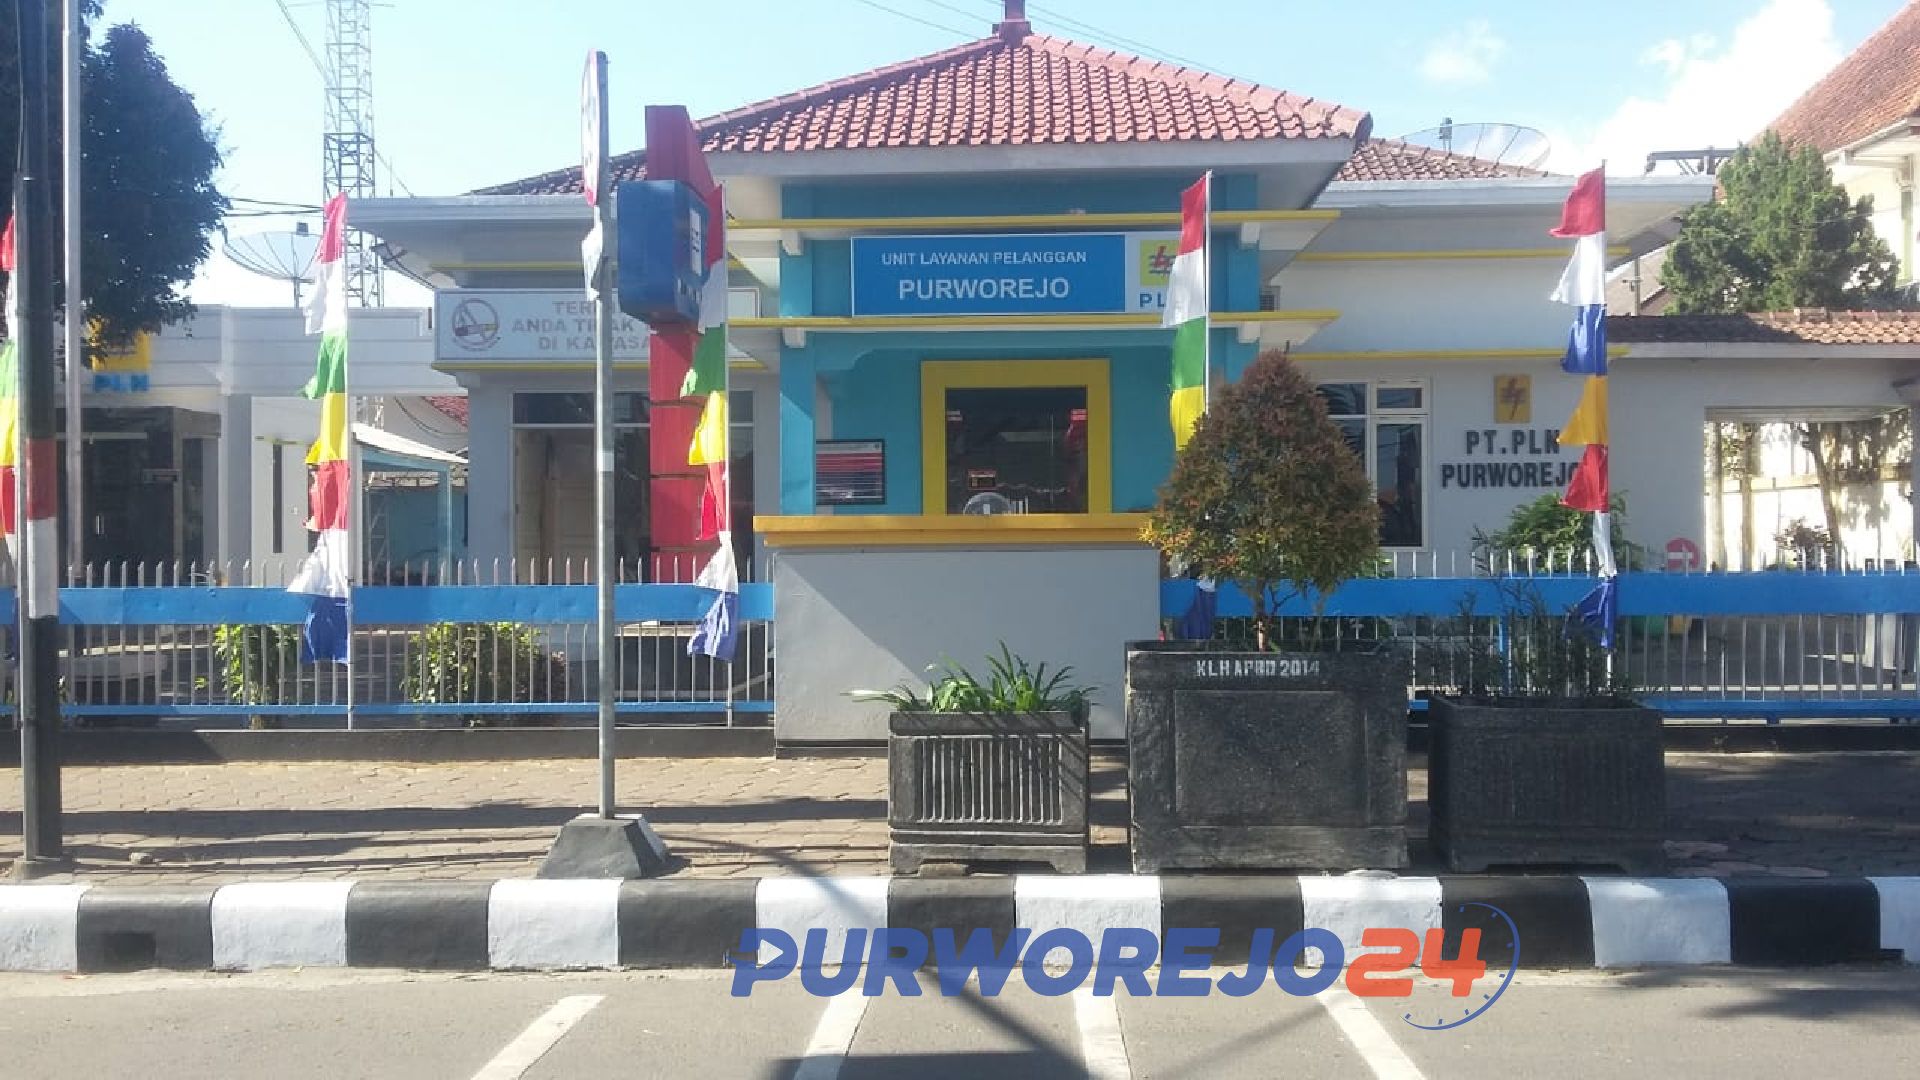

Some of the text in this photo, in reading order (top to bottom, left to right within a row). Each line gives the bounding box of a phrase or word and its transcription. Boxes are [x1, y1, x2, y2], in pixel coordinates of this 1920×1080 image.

[881, 251, 1087, 265] UNIT LAYANAN PELANGGAN
[899, 277, 1070, 300] PURWOREJO
[1139, 292, 1166, 308] PL
[512, 318, 633, 333] ANDA TIAK
[539, 336, 558, 350] DI
[1196, 660, 1230, 676] KLH
[1280, 660, 1320, 676] 2014
